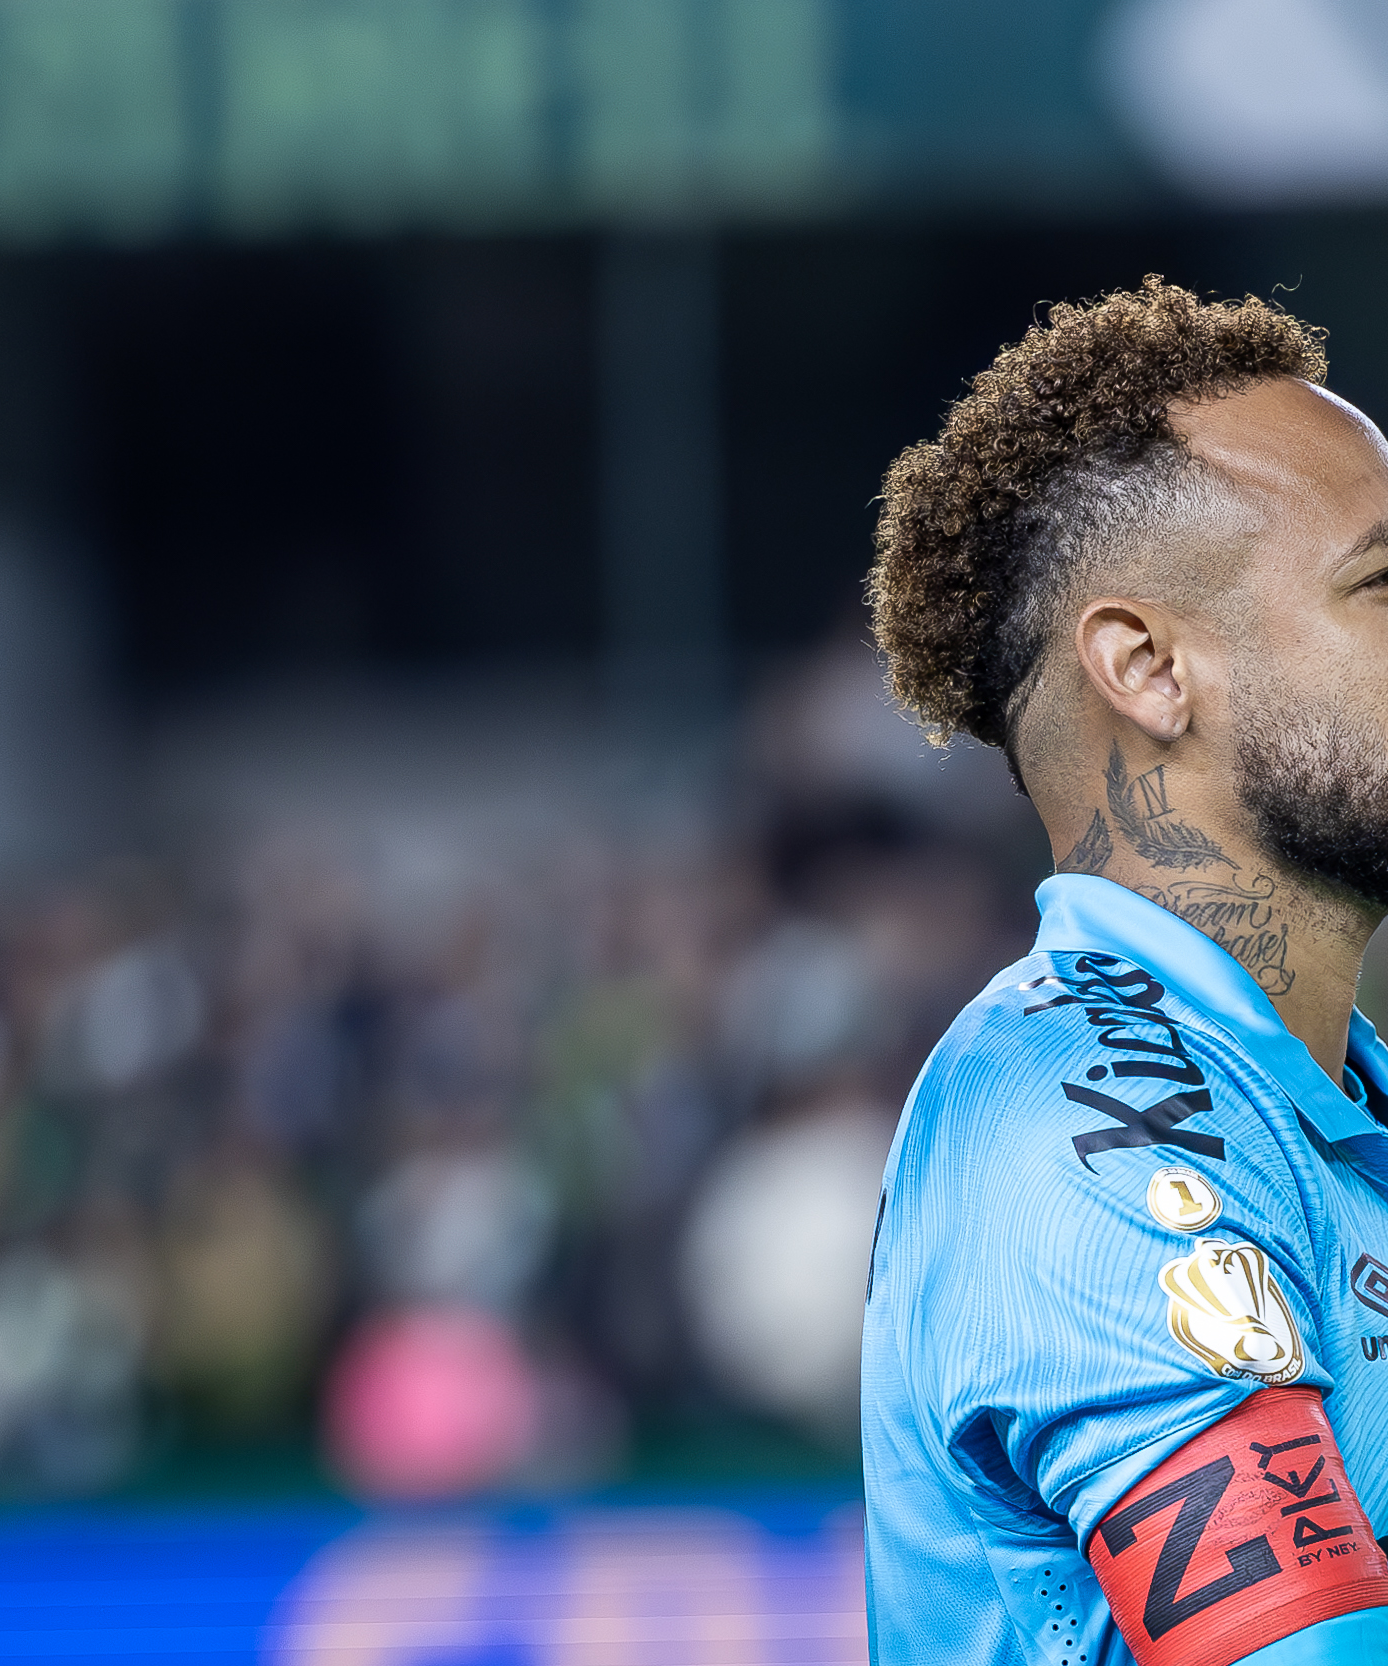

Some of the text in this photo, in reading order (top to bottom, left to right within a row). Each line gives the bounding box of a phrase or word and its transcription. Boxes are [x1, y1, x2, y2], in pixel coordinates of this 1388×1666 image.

[1169, 1181, 1203, 1216] 1
[1263, 1357, 1302, 1383] BRASIL
[1099, 1455, 1284, 1643] Z
[1297, 1549, 1322, 1568] BY
